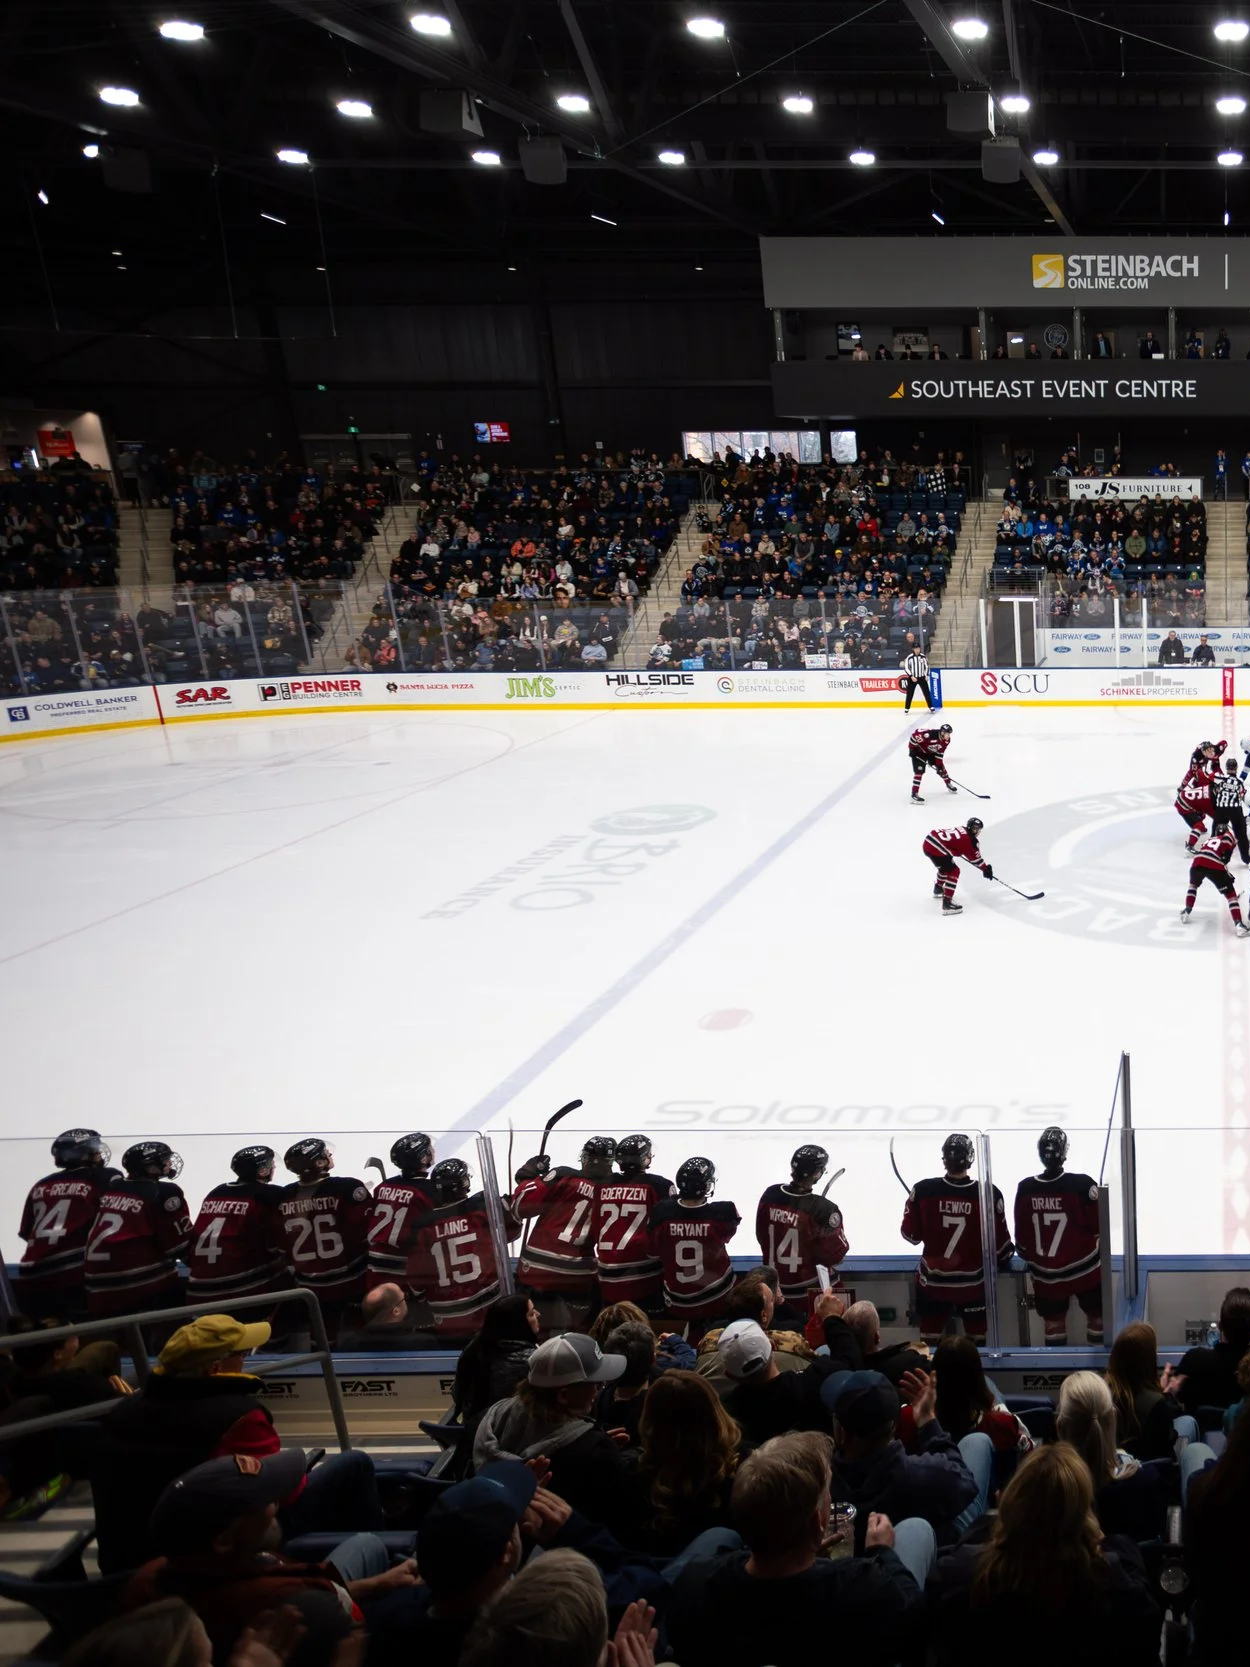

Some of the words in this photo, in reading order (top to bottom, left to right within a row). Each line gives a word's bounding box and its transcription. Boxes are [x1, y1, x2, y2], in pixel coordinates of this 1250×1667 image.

[1067, 255, 1199, 277] STEINBACH
[1068, 278, 1149, 290] ONLINE.COM
[911, 380, 1034, 398] SOUTHEAST
[1042, 380, 1108, 398] EVENT
[1115, 380, 1197, 398] CENTRE
[1095, 482, 1120, 495] JS
[1122, 484, 1183, 493] FURNITURE
[290, 679, 362, 693] PENNER
[505, 674, 556, 699] JIM'S
[605, 674, 694, 686] HILLSIDE
[827, 680, 859, 689] STEINBACH
[862, 679, 889, 689] TRAILERS
[1000, 673, 1050, 694] SCU
[34, 699, 90, 712] COLDWELL
[96, 695, 138, 705] BANKER
[292, 692, 331, 700] BUILDING
[333, 690, 363, 698] CENTRE
[418, 834, 589, 921] INSURANCE
[509, 837, 684, 911] BRIO
[645, 1098, 1069, 1126] Solomon's
[378, 1186, 414, 1204] DRAPER
[600, 1186, 647, 1201] GOERTZEN
[100, 1195, 144, 1213] SCHAMPS
[200, 1200, 249, 1215] SCHAEFER
[279, 1196, 339, 1216] ORTHINGTON
[939, 1200, 972, 1215] LEWKO
[1031, 1197, 1063, 1211] DRAKE
[173, 1216, 193, 1236] 12
[367, 1203, 409, 1248] 21
[769, 1207, 799, 1226] WRIGHT
[435, 1218, 469, 1238] LAING
[599, 1203, 648, 1250] 27
[670, 1223, 710, 1237] BRYANT
[1031, 1213, 1068, 1258] 17
[195, 1217, 226, 1264] 4
[284, 1213, 344, 1262] 26
[942, 1215, 966, 1259] 7
[768, 1224, 803, 1273] 14
[430, 1232, 482, 1288] 15
[675, 1240, 704, 1283] 9
[262, 1382, 297, 1394] AST
[341, 1380, 396, 1391] FAST
